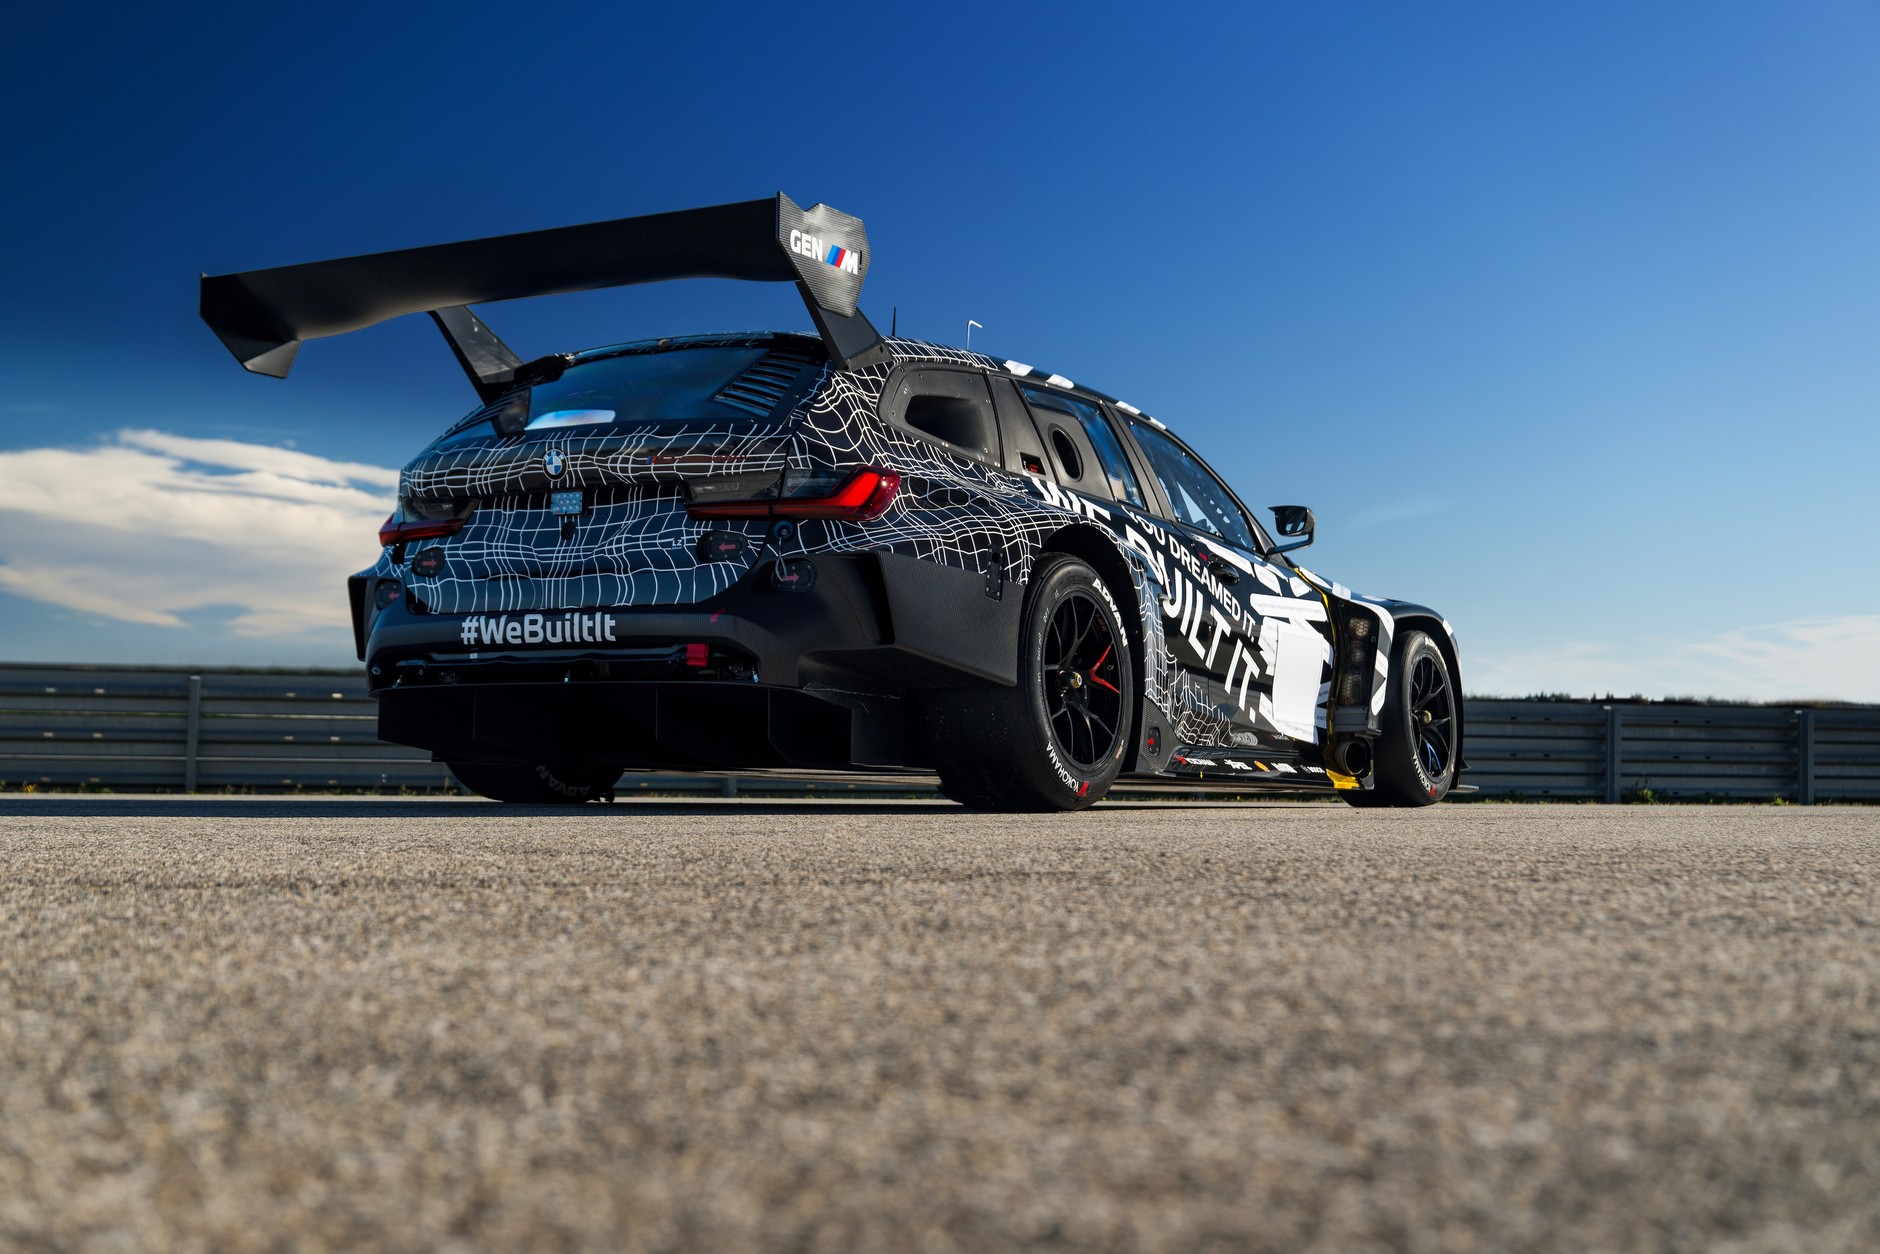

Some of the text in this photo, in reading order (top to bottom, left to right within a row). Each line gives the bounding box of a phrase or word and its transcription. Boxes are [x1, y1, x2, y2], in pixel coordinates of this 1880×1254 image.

[790, 229, 823, 262] GEN
[1121, 505, 1256, 643] YOU DREAMED IT.
[460, 611, 617, 646] #WeBuiltIt
[1092, 578, 1128, 647] ADVAN
[1224, 639, 1260, 724] IT.
[1045, 739, 1080, 793] YOKOHAMA
